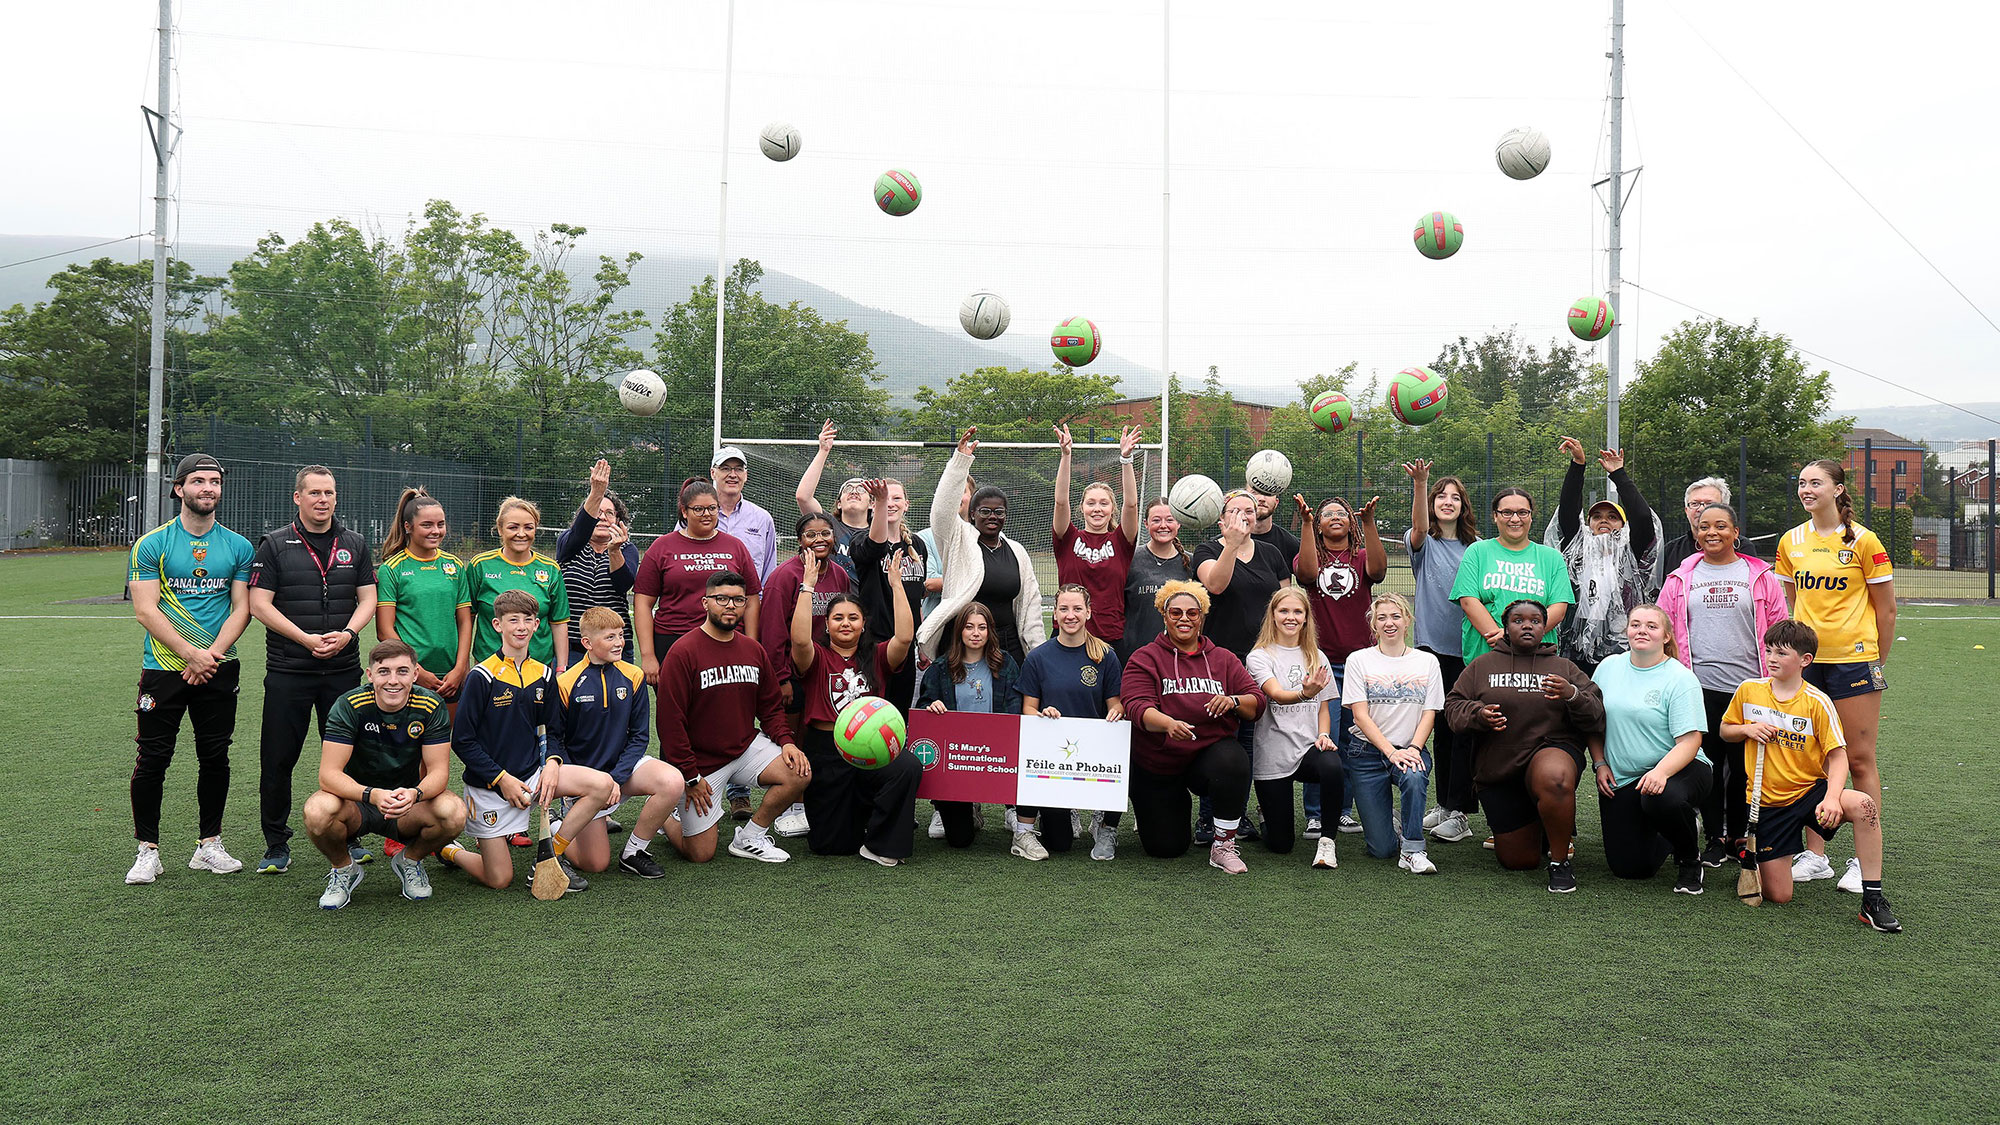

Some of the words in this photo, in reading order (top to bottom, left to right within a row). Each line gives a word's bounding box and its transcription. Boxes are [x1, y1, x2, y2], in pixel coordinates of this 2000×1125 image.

[1495, 559, 1536, 577] YORK
[167, 577, 198, 588] CANAL
[1483, 572, 1545, 597] COLLEGE
[1794, 570, 1848, 592] fibrus
[1138, 586, 1158, 595] ALPHA
[1702, 594, 1739, 603] KNIGHTS
[700, 665, 760, 690] BELLARMINE
[948, 742, 959, 751] St
[960, 743, 991, 754] Mary's
[948, 752, 1007, 763] International
[947, 762, 985, 772] Summer
[986, 764, 1018, 774] School
[1026, 759, 1055, 770] Féile
[1058, 763, 1073, 771] an
[1076, 762, 1122, 774] Phobail
